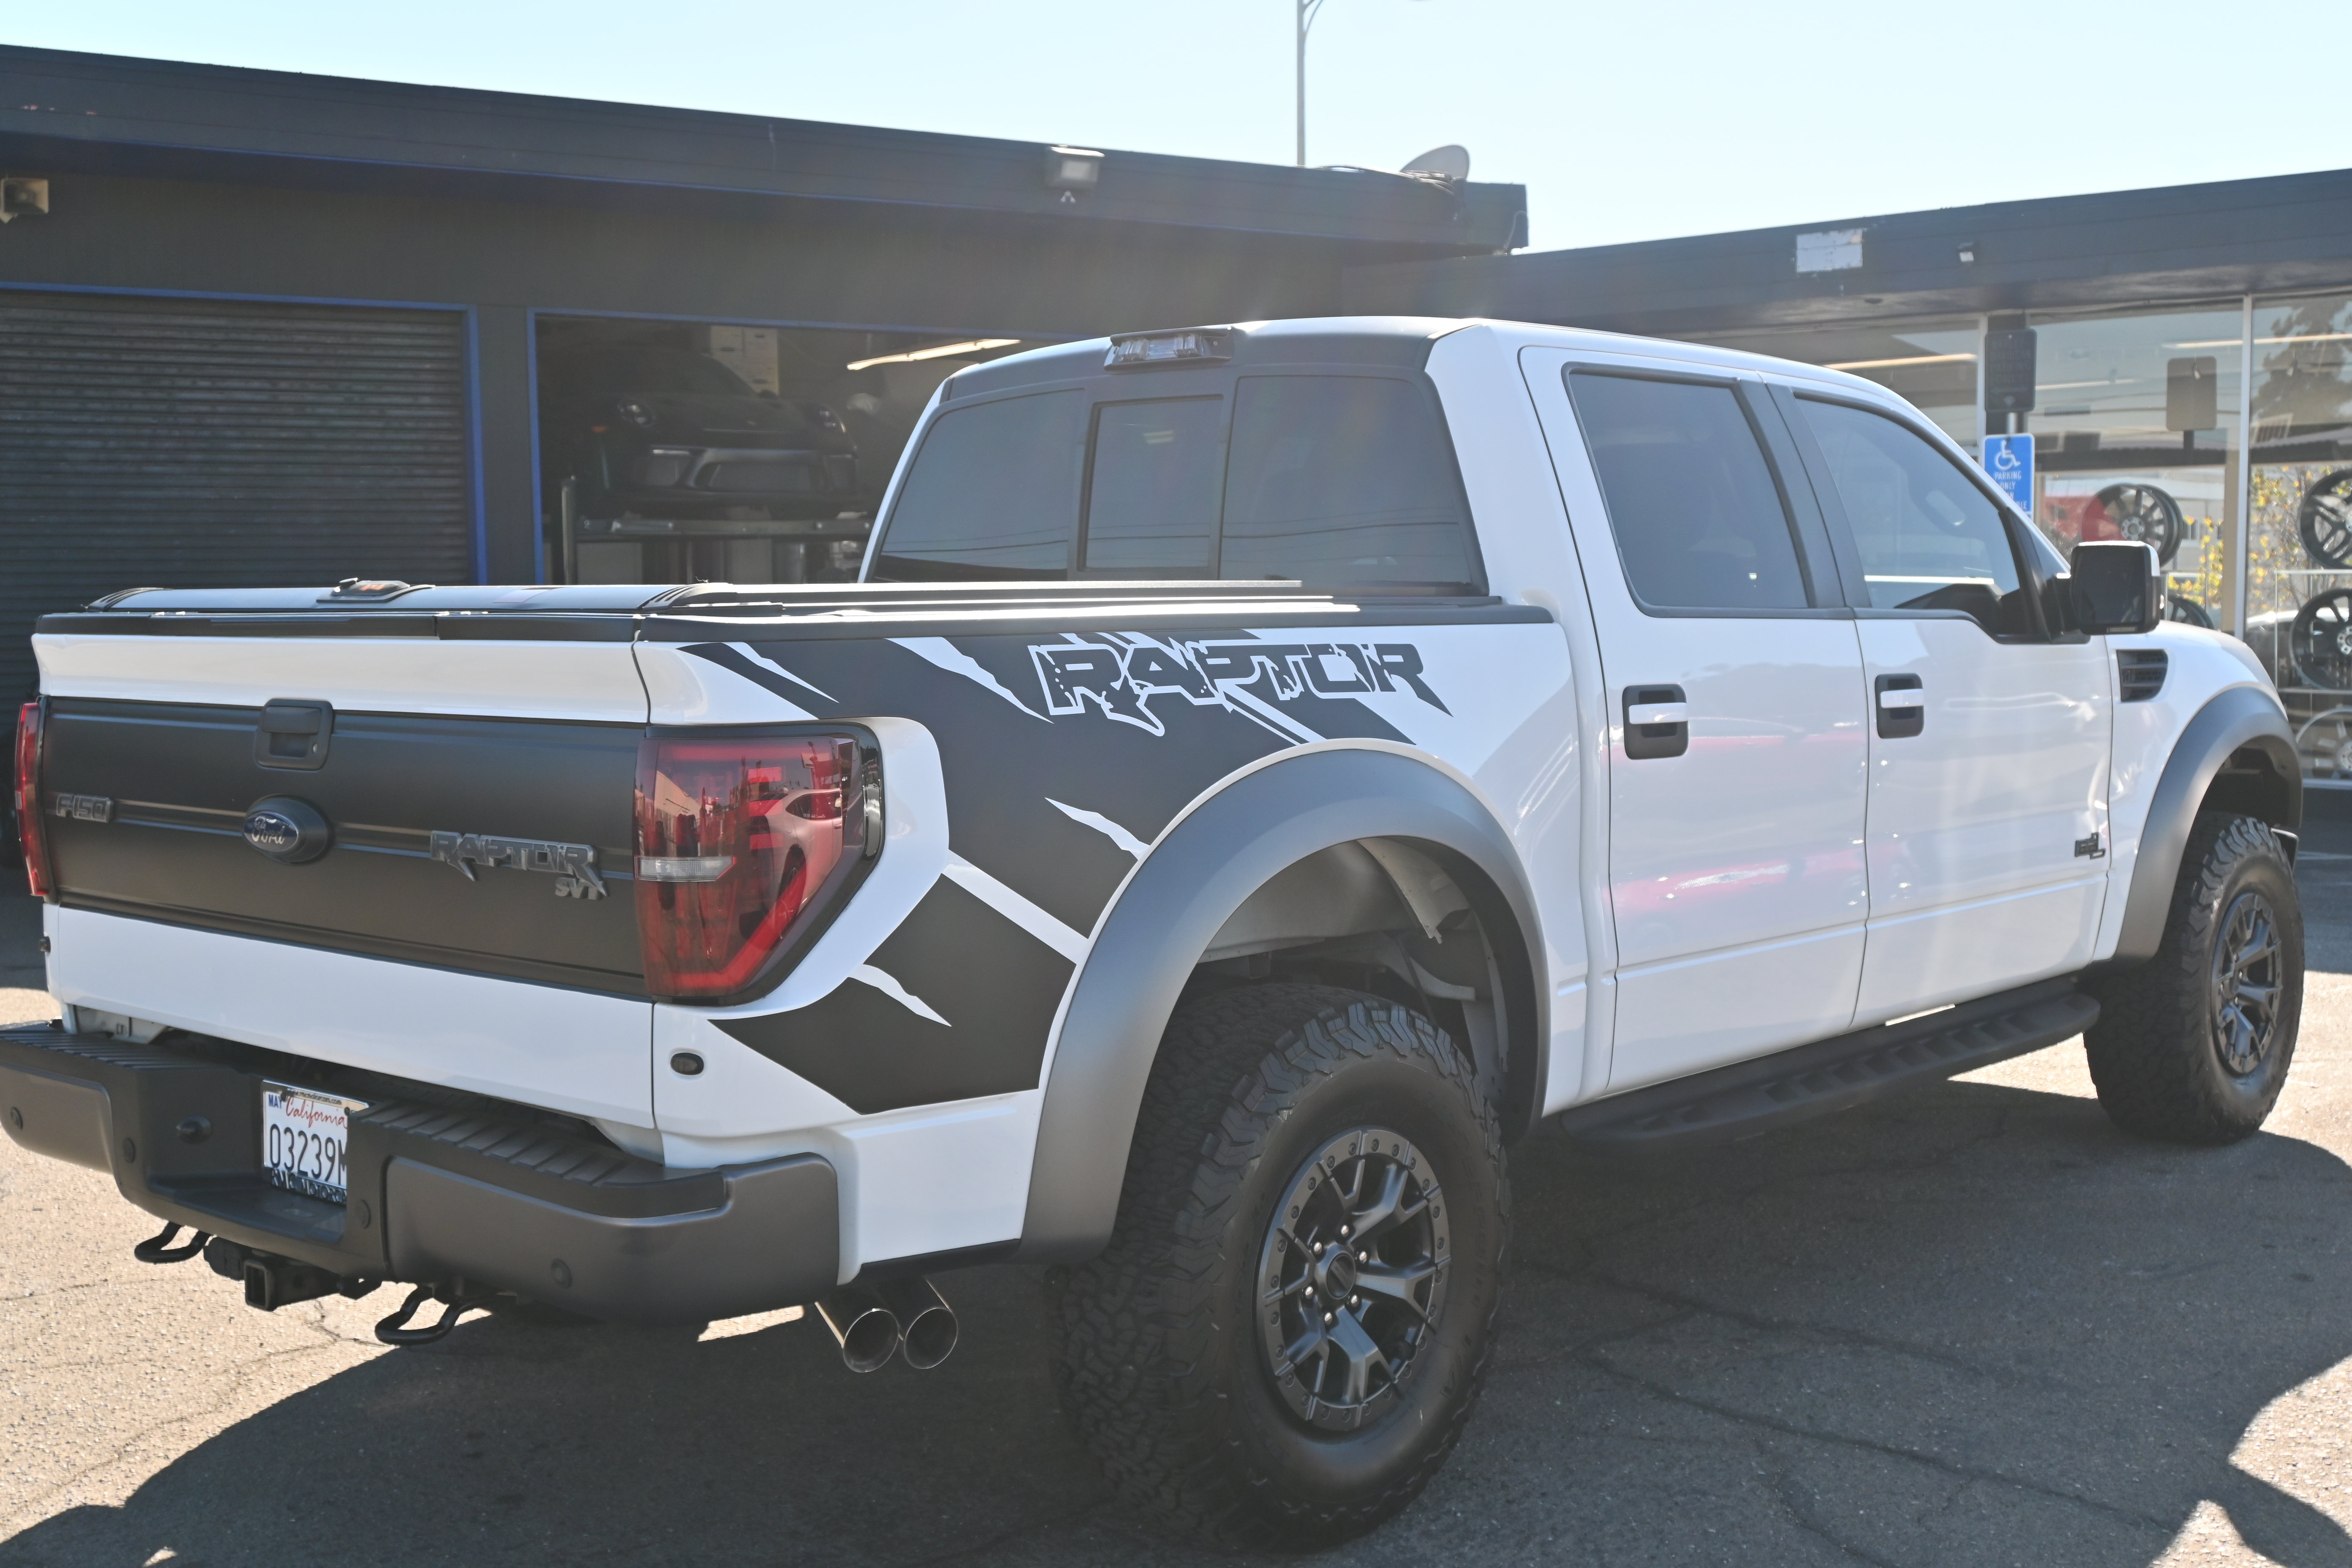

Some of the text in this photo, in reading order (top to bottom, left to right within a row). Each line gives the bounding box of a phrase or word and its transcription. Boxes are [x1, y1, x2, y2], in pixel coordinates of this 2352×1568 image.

[1994, 471, 2022, 480] PARKING
[2000, 481, 2016, 490] ONLY
[1028, 639, 1454, 737] RAPTOR
[251, 816, 285, 844] Ford
[430, 830, 607, 897] RAPTOR
[554, 876, 601, 900] SVT
[268, 1094, 282, 1109] MAY
[286, 1095, 347, 1130] California
